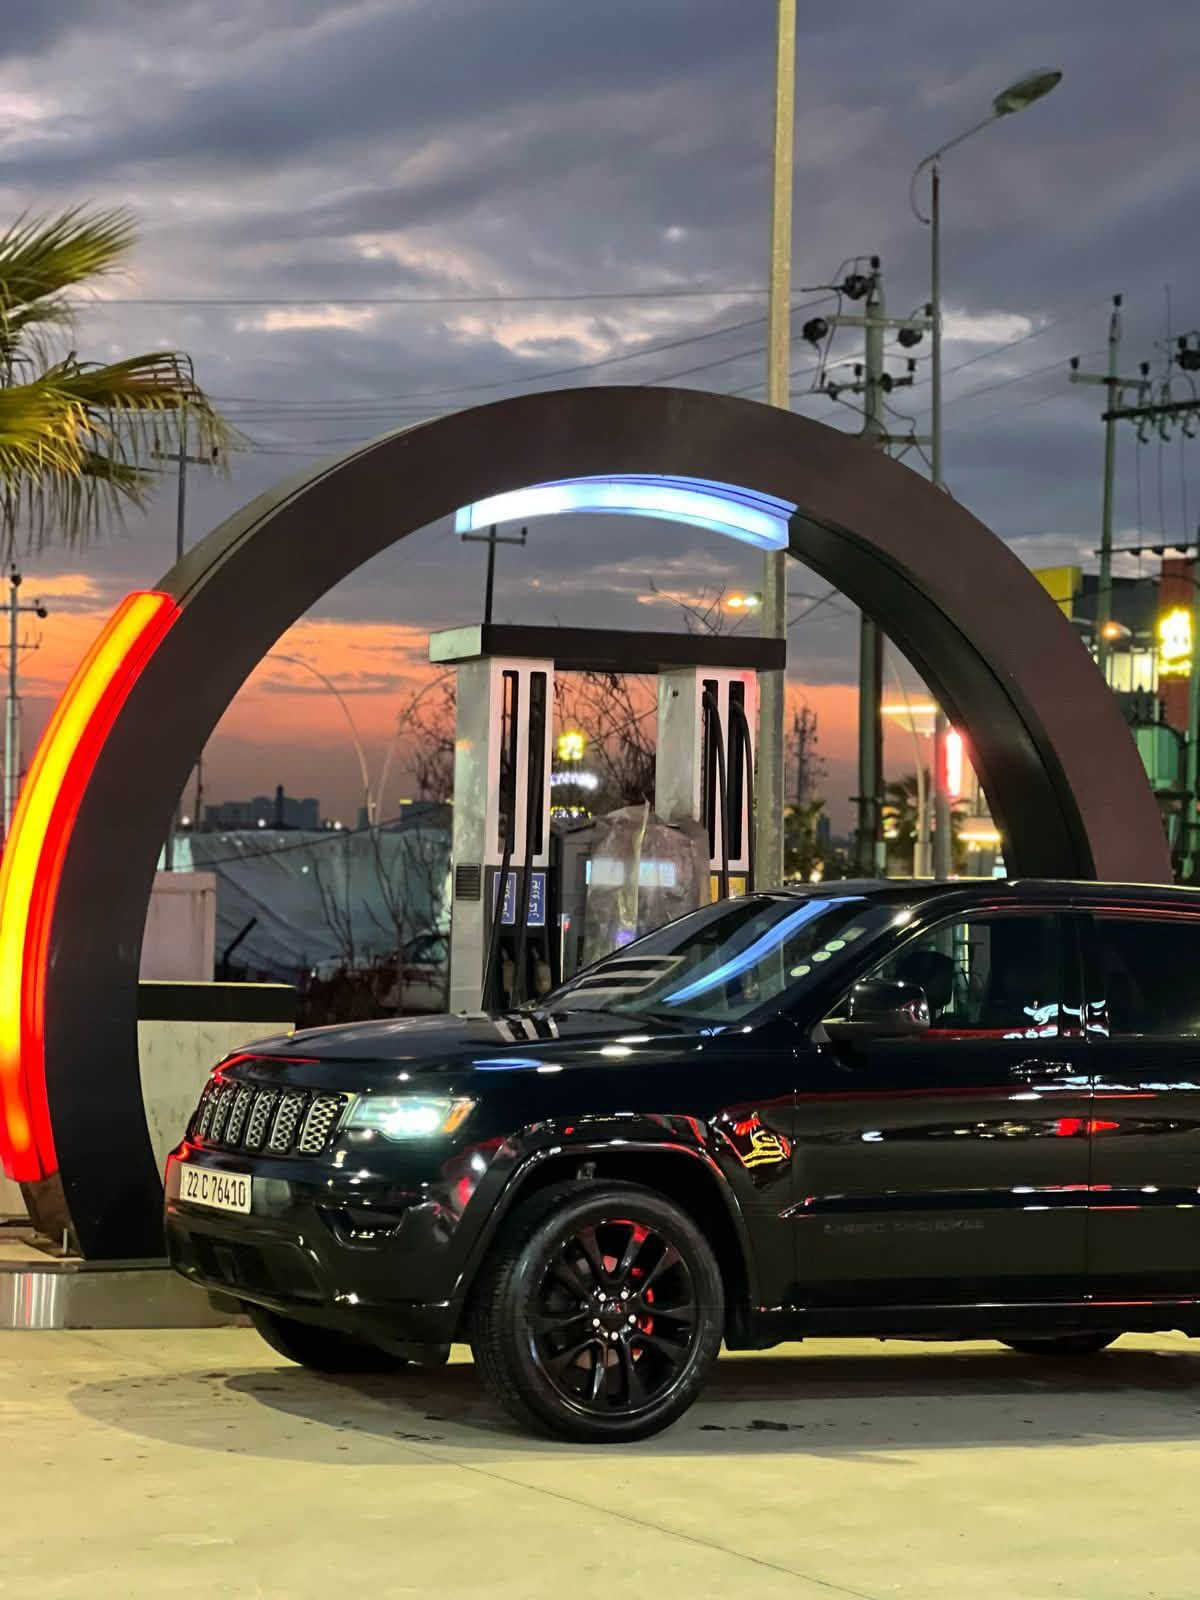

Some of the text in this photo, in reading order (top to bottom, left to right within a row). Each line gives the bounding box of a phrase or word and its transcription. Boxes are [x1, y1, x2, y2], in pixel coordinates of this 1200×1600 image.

[187, 1171, 246, 1207] 22 C 76410
